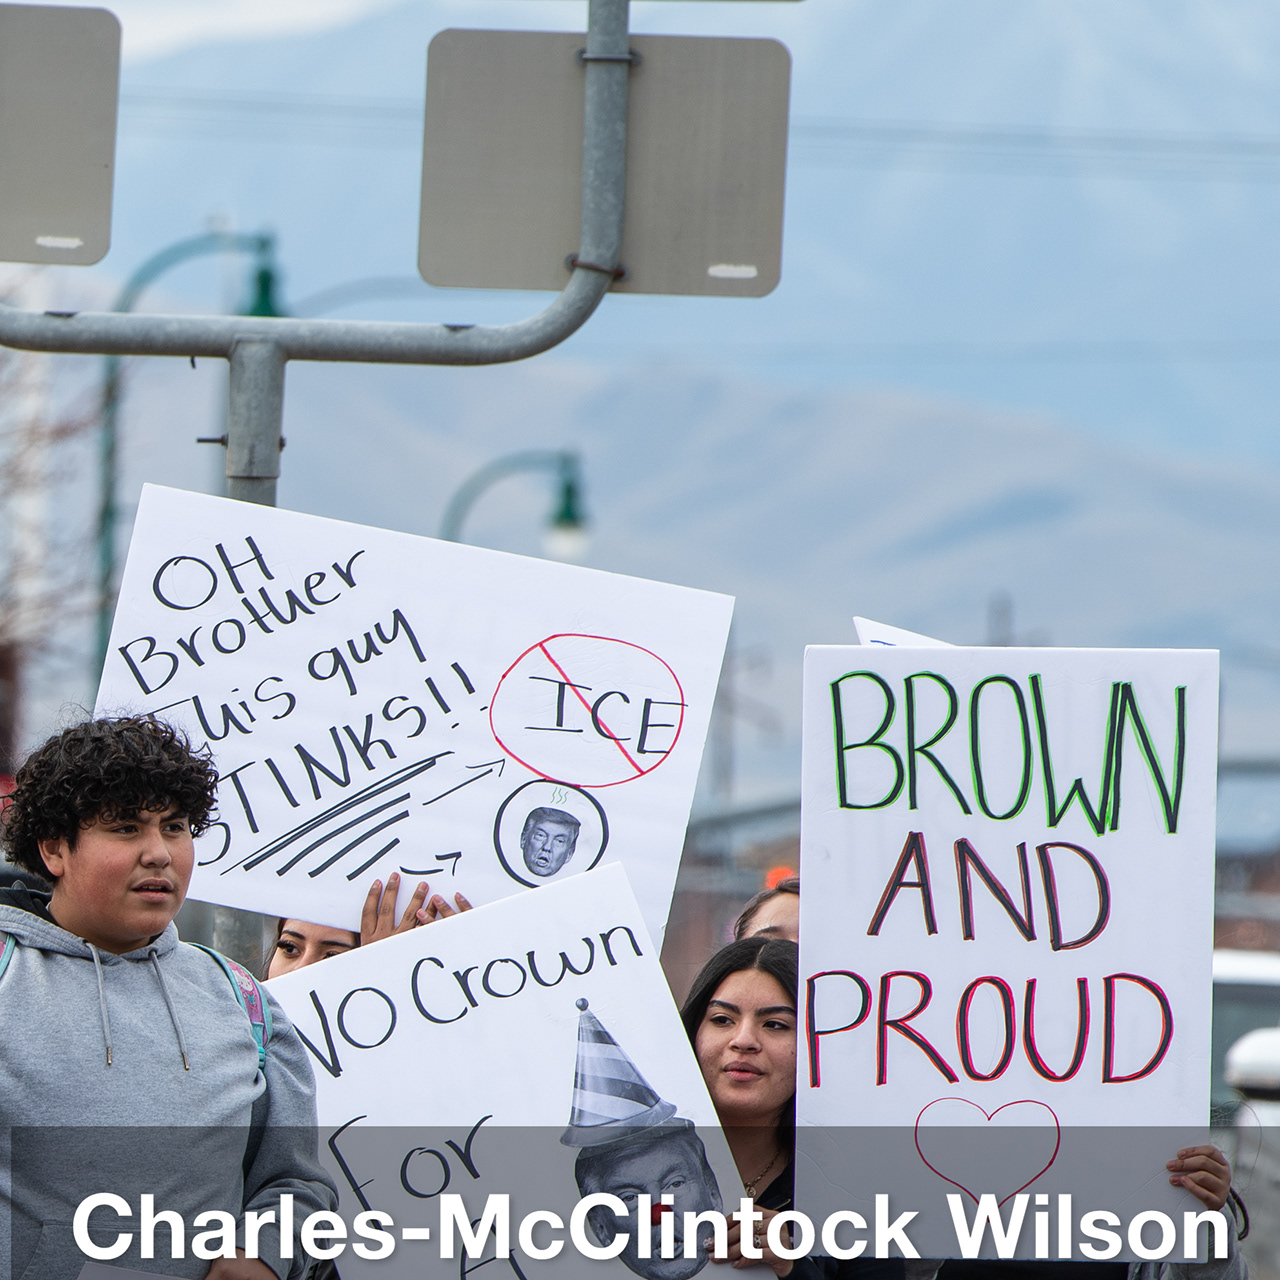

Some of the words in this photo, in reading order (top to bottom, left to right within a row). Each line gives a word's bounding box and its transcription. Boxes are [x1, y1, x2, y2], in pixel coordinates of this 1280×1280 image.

[152, 535, 275, 610] OH
[307, 608, 427, 697] guy
[524, 676, 689, 754] ICE
[829, 670, 1187, 837] BROWN
[866, 830, 1112, 952] AND
[410, 924, 643, 1025] Crown
[805, 969, 1174, 1088] PROUD
